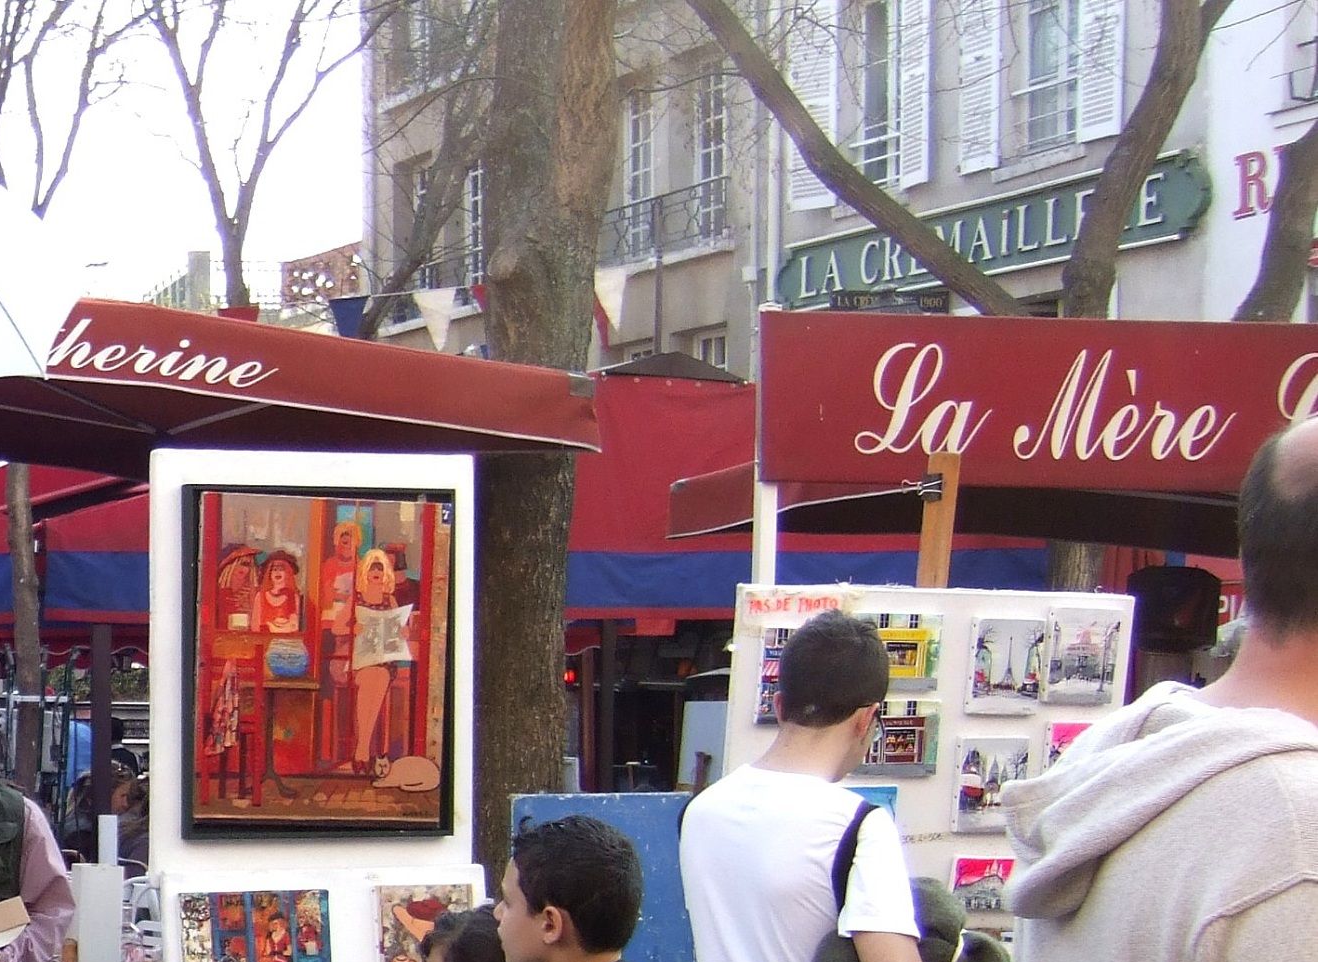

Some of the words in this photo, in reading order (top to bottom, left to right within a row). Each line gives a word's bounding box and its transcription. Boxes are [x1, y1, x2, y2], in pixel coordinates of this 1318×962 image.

[798, 250, 844, 299] LA
[47, 318, 279, 388] herine
[854, 342, 993, 455] La
[1013, 348, 1236, 462] Mère
[776, 598, 792, 611] DE
